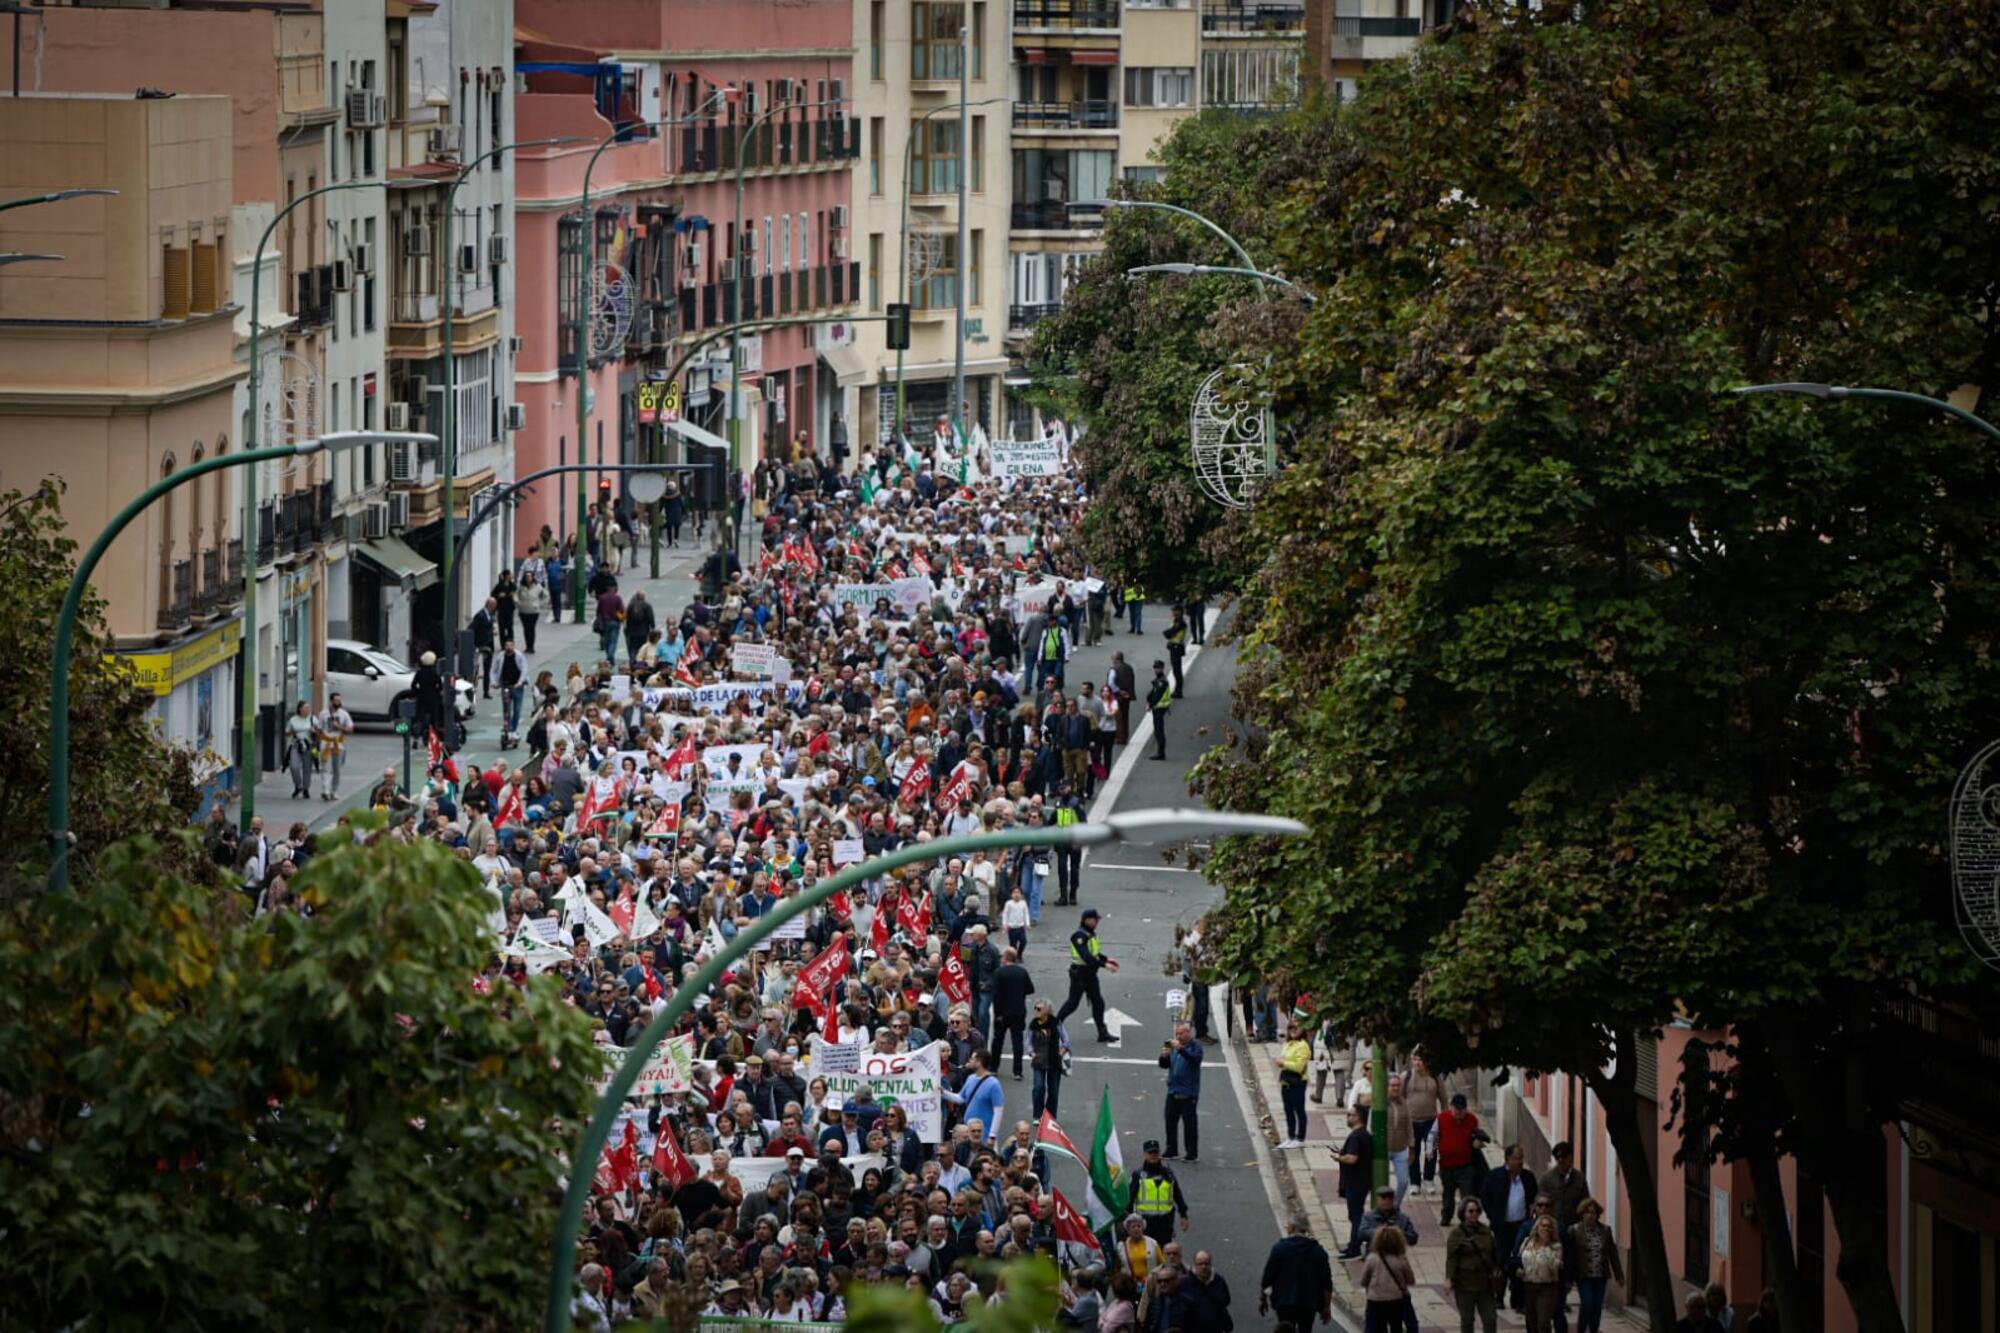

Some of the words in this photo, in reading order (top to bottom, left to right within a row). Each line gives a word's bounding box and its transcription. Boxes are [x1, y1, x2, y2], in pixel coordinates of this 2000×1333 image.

[643, 397, 675, 408] OO
[1006, 464, 1045, 475] GILENA
[700, 690, 713, 702] DE
[715, 689, 730, 701] LA
[868, 1078, 918, 1094] MENTAL
[920, 1078, 935, 1092] YA
